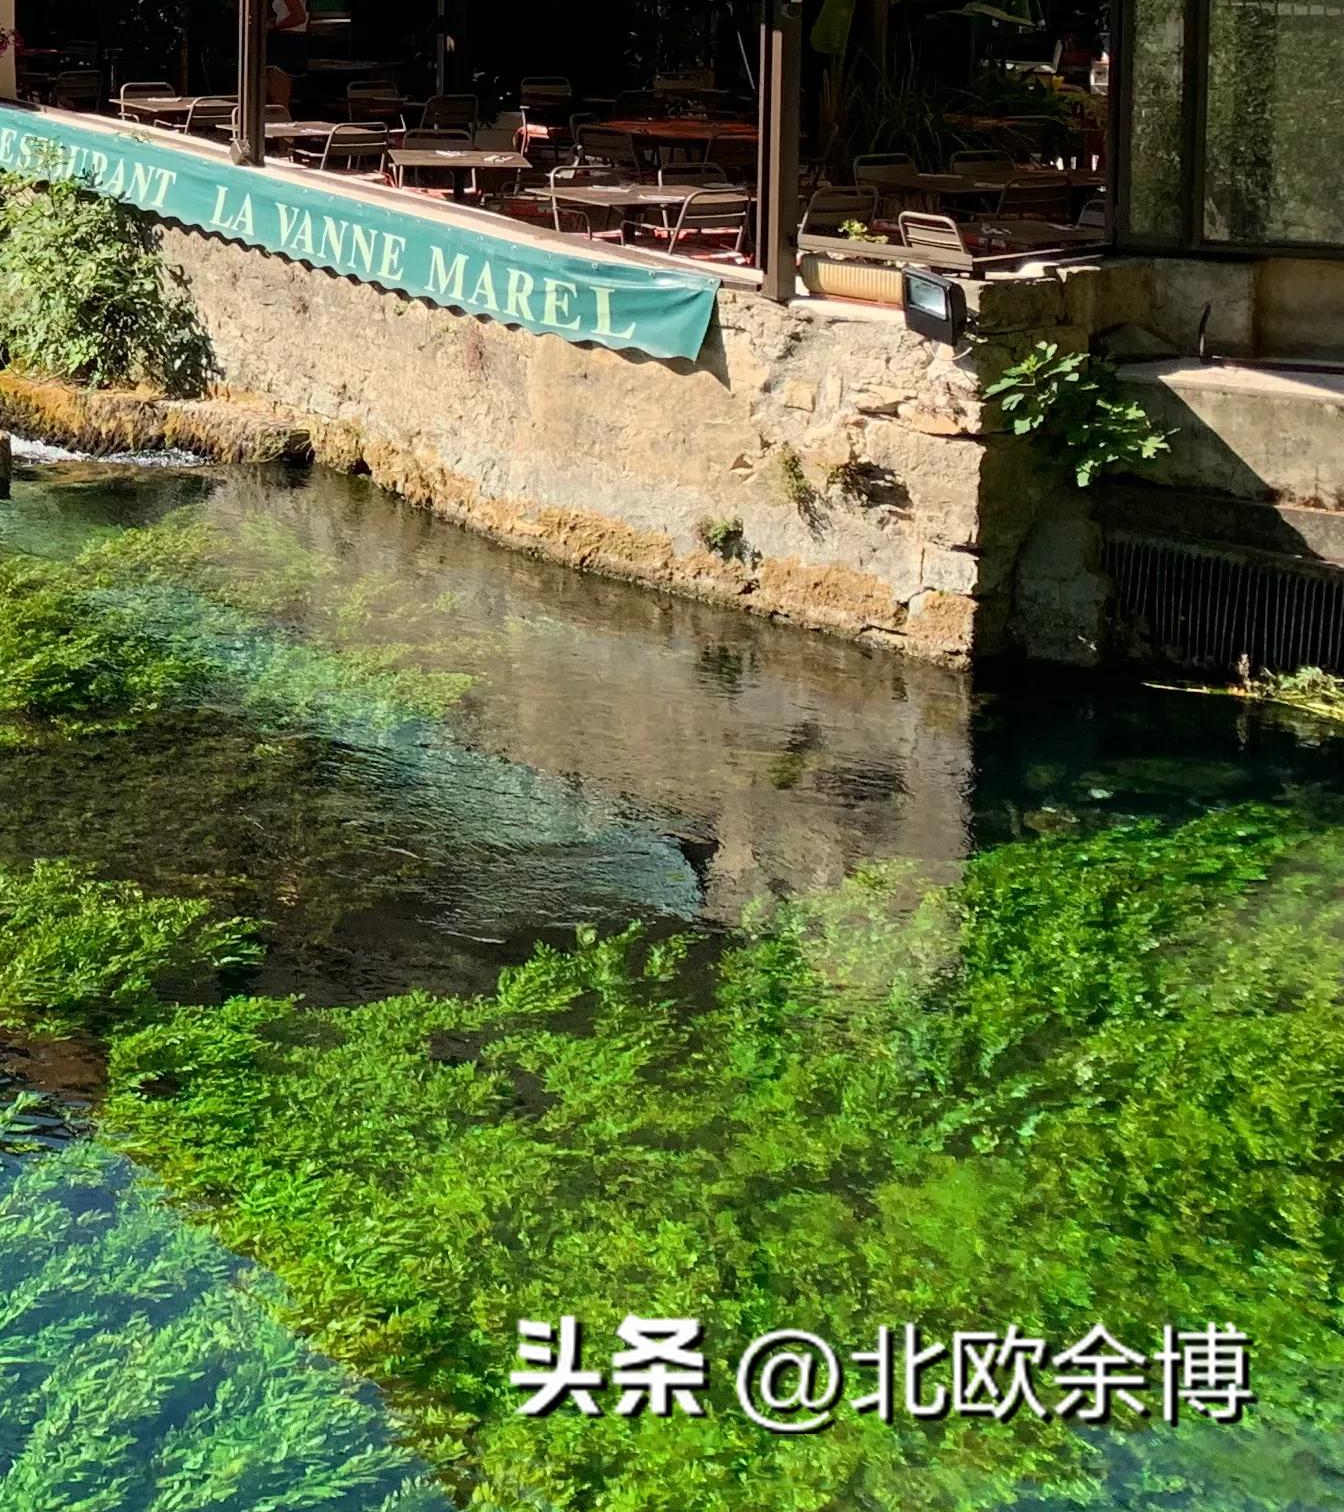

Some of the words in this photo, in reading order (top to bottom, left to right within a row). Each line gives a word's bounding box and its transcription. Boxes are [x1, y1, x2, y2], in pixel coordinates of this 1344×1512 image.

[209, 185, 255, 236] LA
[274, 201, 407, 281] VANNE
[423, 245, 637, 340] MAREL
